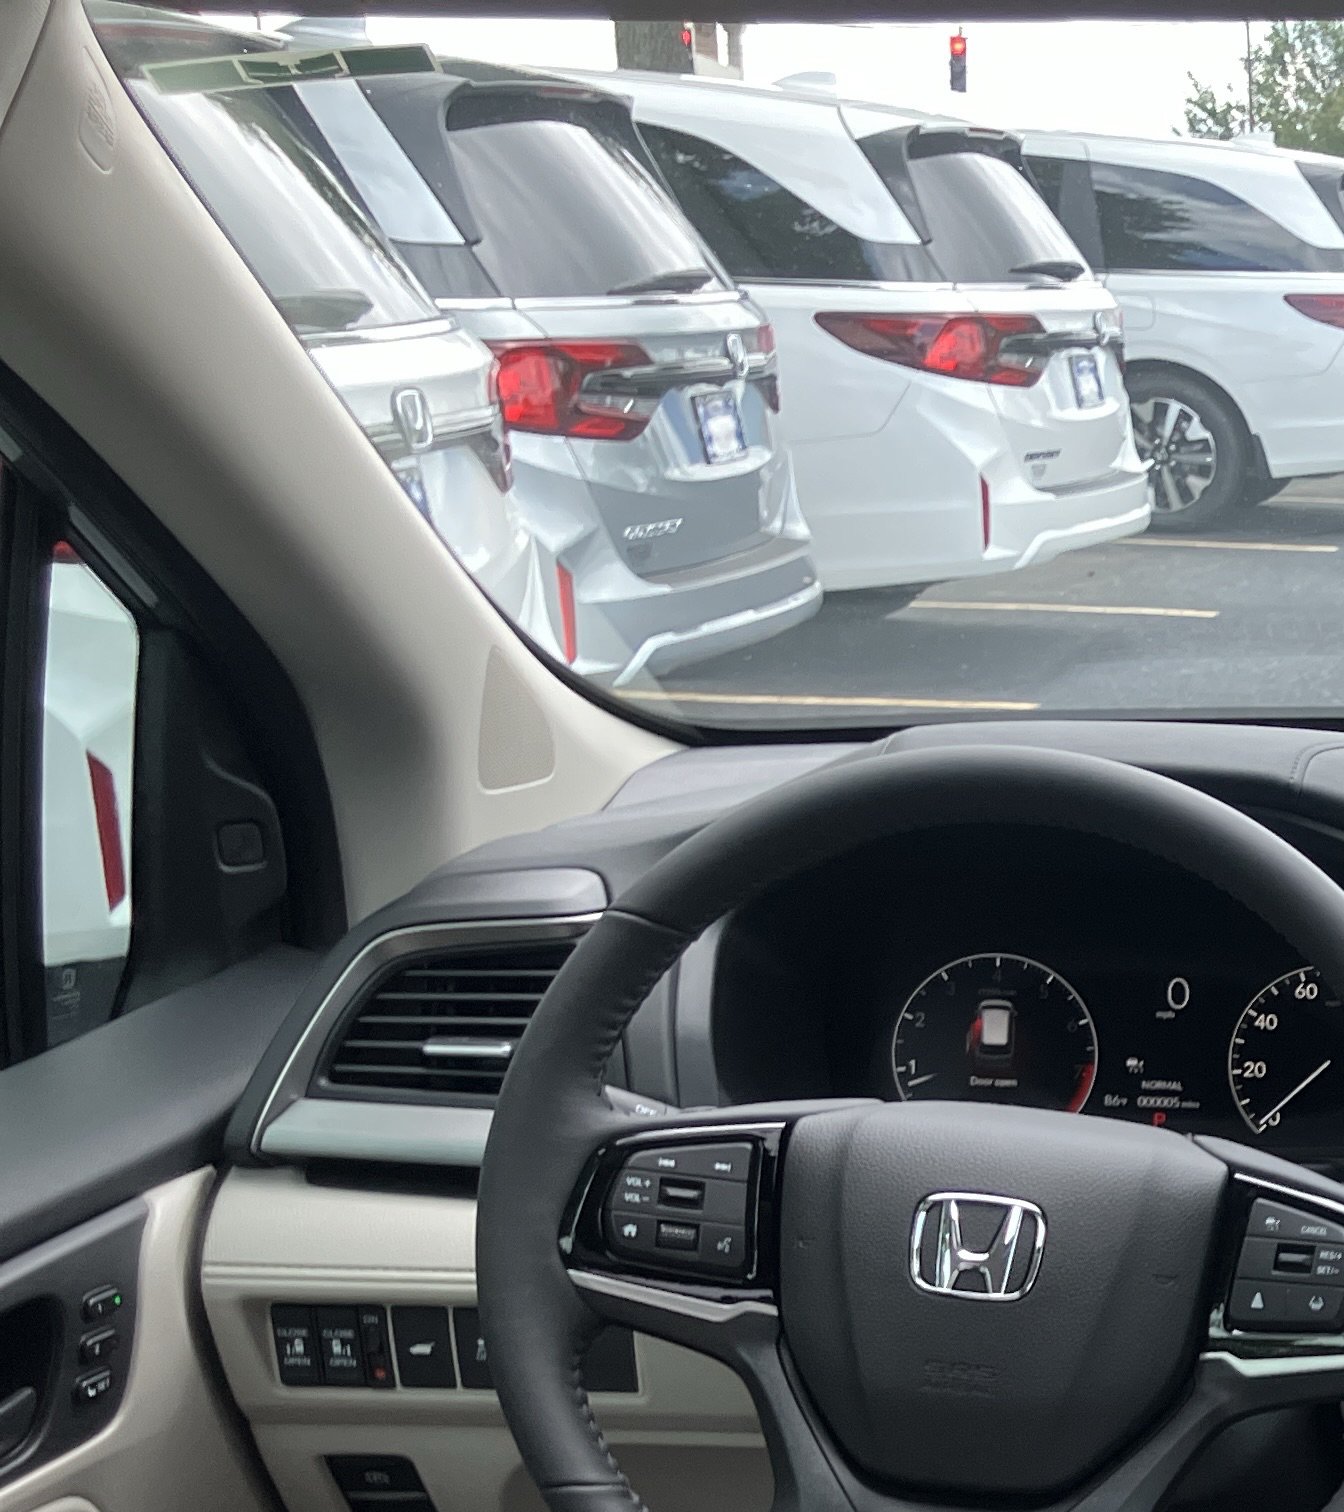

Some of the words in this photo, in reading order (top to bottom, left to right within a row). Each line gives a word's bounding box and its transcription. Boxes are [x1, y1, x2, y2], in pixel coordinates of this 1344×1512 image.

[1167, 977, 1190, 1010] 0
[1294, 982, 1319, 1001] 60
[914, 1011, 926, 1028] 2
[1254, 1013, 1279, 1031] 40
[908, 1058, 917, 1075] 1
[1242, 1060, 1267, 1079] 20
[969, 1075, 993, 1087] Door
[1141, 1079, 1184, 1092] NORMAL
[1152, 1111, 1167, 1127] P
